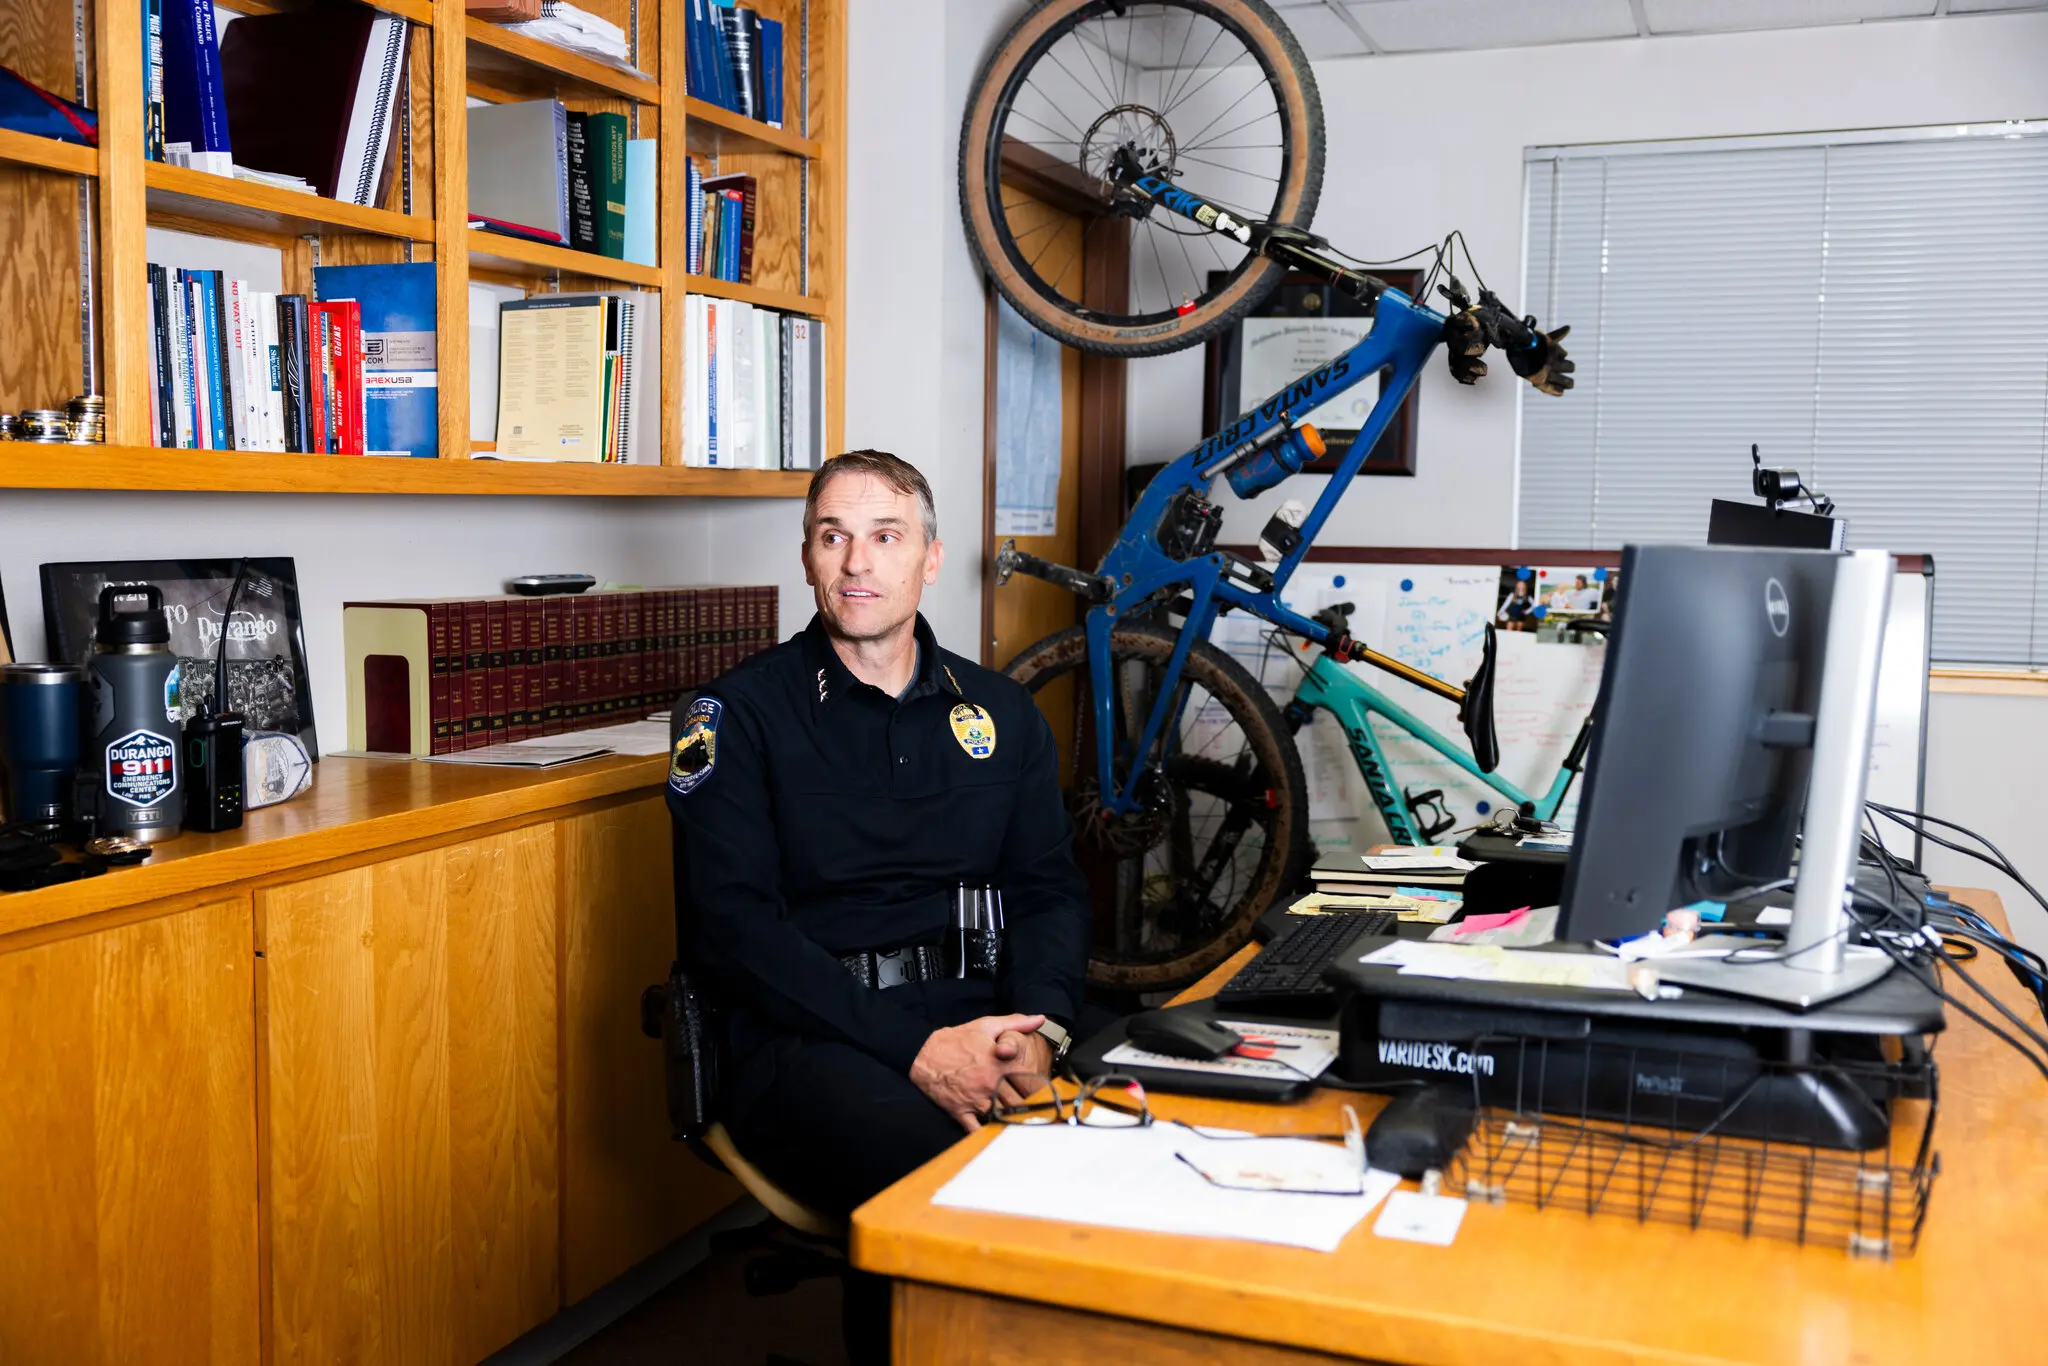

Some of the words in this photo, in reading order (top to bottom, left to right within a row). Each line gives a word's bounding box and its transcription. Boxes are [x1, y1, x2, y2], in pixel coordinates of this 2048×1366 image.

[194, 6, 205, 45] COMMAND
[203, 14, 213, 42] POLICE
[232, 281, 238, 296] NO
[313, 313, 318, 323] ON
[234, 328, 242, 350] OUT
[334, 326, 342, 357] SWIPED
[795, 324, 806, 340] 32
[270, 350, 278, 363] Ship
[182, 357, 191, 407] MANAGEMENT
[272, 364, 280, 387] Around!
[1259, 354, 1350, 421] SANTA
[1192, 414, 1256, 469] CRUZ
[163, 604, 188, 634] TO
[197, 614, 277, 641] Durango
[111, 746, 172, 760] DURANGO
[122, 758, 164, 776] 911
[1352, 727, 1396, 808] SANTA
[113, 779, 170, 788] COMMUNICATIONS
[122, 774, 163, 783] EMERGENCY
[129, 811, 162, 821] YETI
[1378, 1040, 1494, 1076] VARIDESK.com
